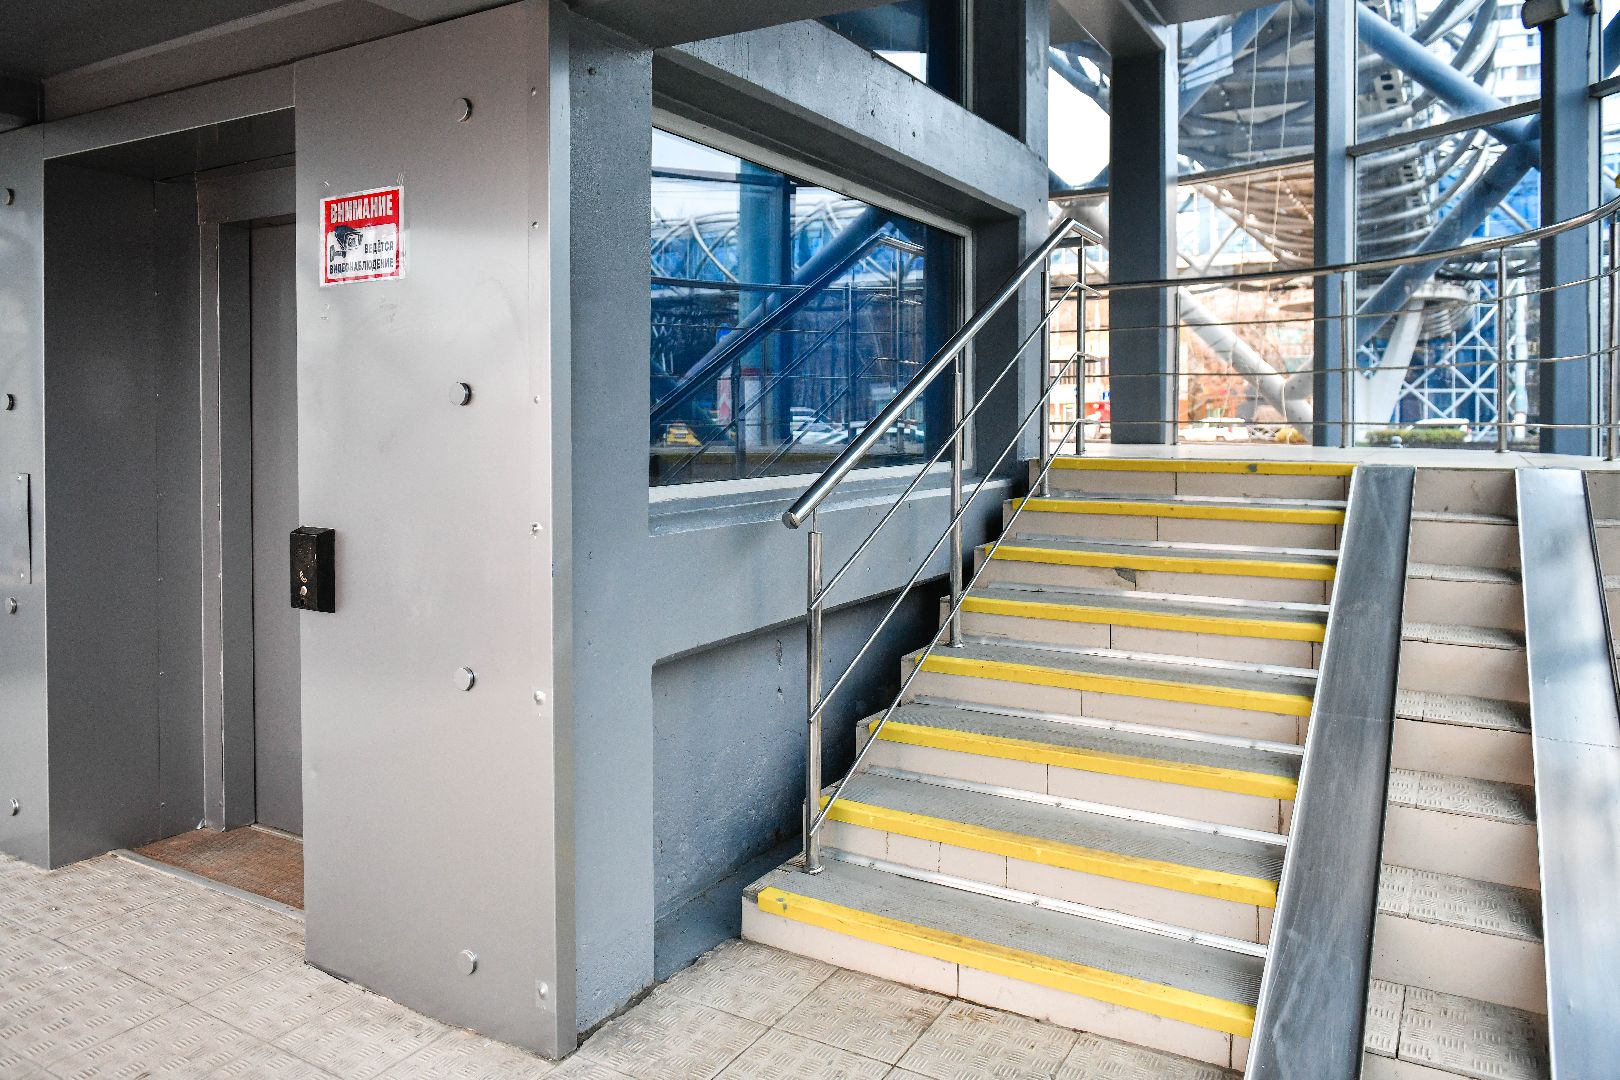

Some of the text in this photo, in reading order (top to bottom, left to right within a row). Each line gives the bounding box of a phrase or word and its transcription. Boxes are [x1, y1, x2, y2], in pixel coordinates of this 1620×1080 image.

[330, 194, 393, 223] ВНИМАНИЕ
[364, 240, 394, 254] ВЕДЁТСЯ
[329, 258, 394, 274] ВИДЕОНАБЛЮДЕНИЕ
